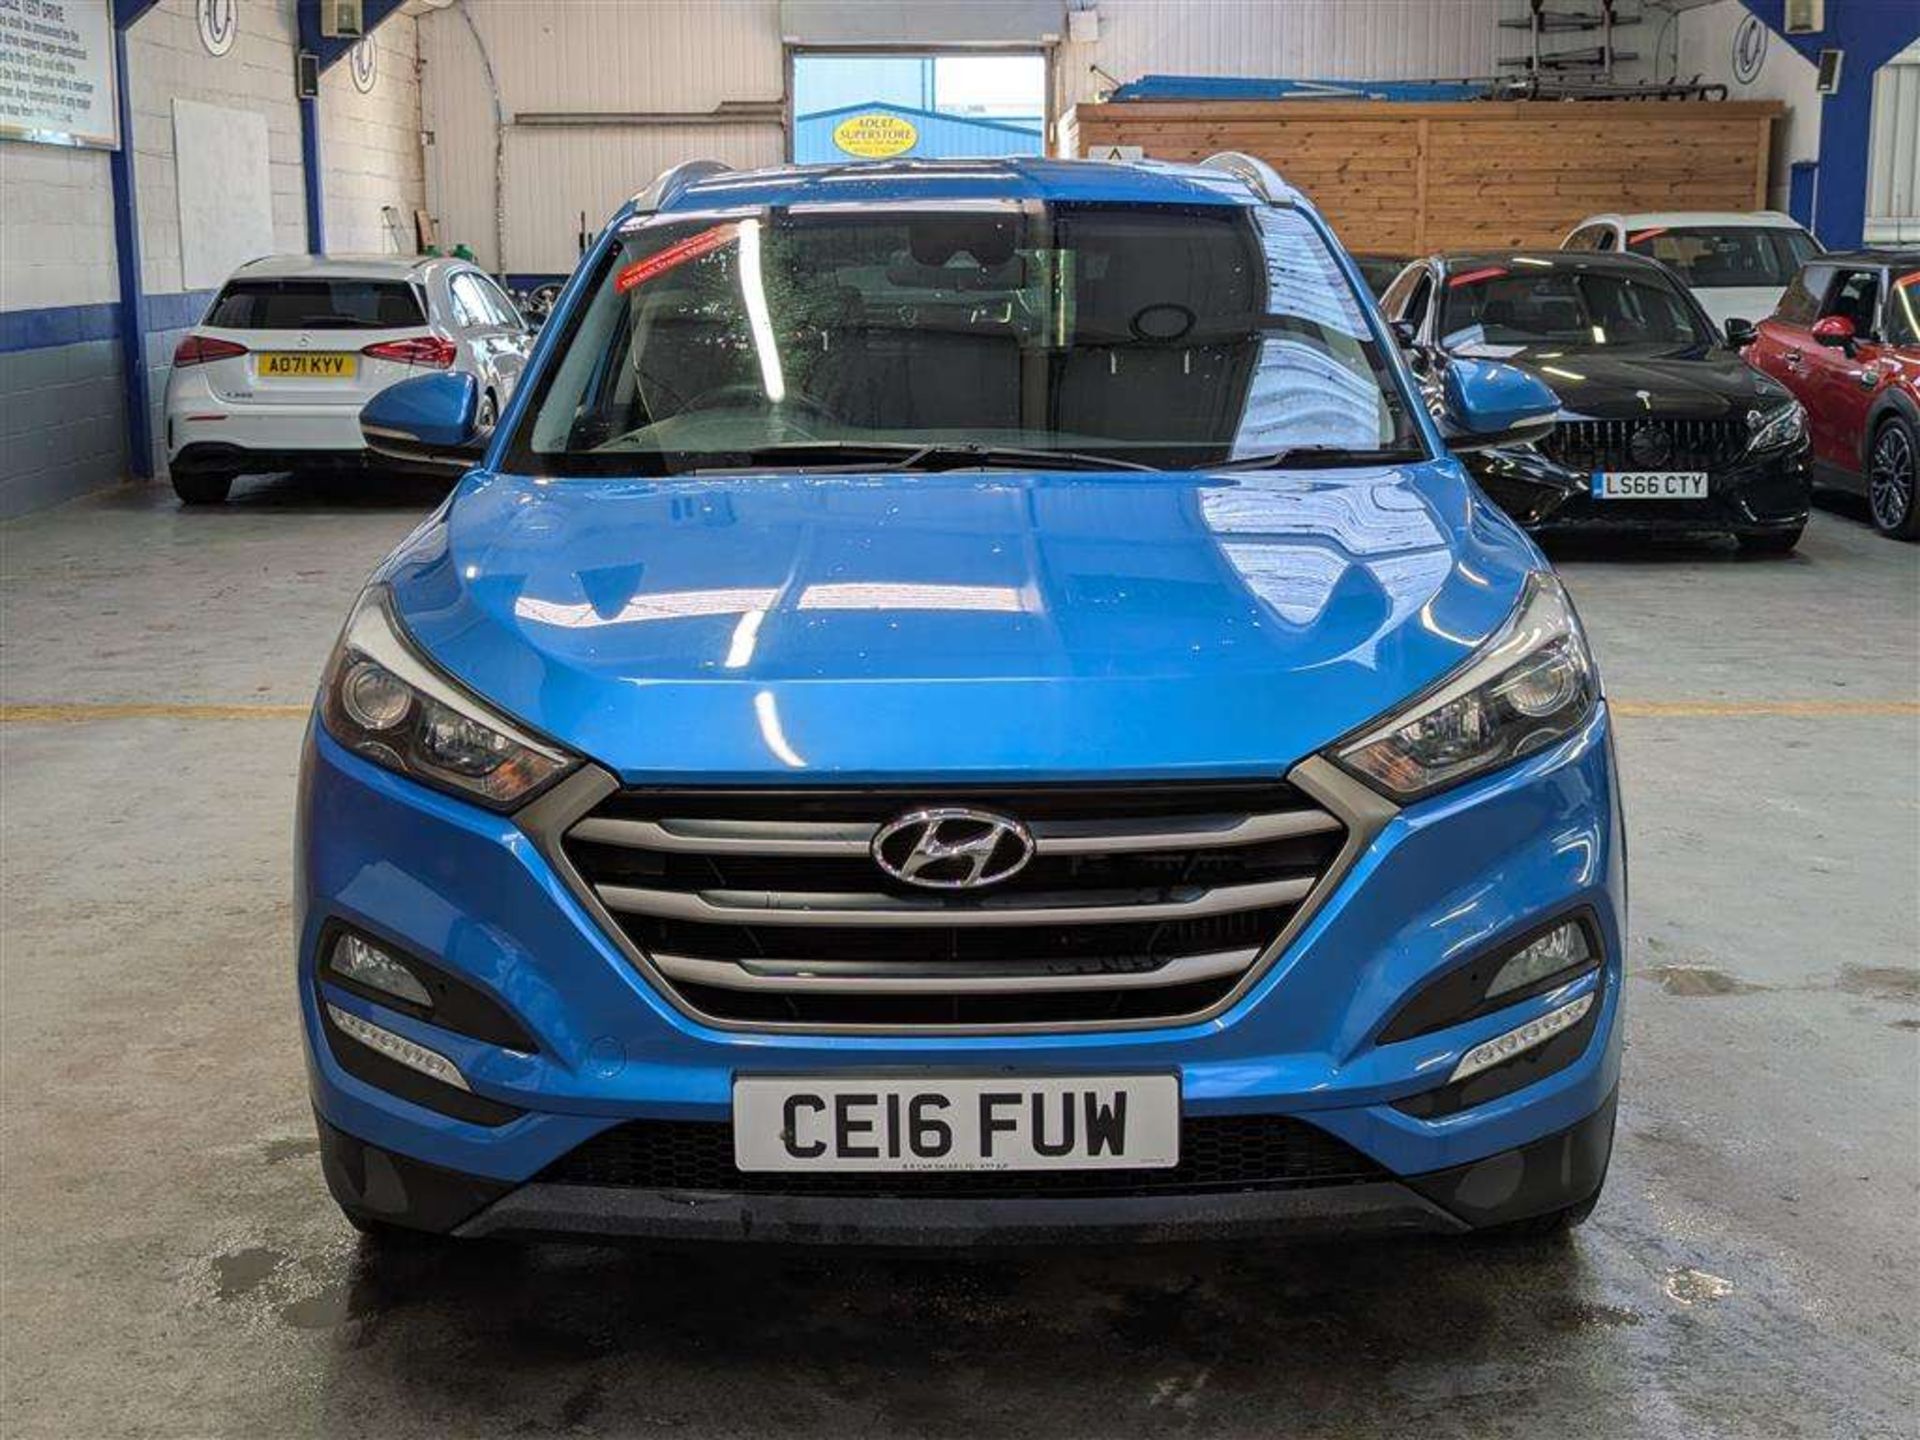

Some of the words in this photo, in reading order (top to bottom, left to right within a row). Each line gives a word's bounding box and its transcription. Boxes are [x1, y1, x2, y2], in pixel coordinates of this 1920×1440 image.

[841, 129, 911, 140] SUPERSTORE
[310, 354, 344, 373] KYV
[1606, 475, 1659, 494] LS66
[1665, 475, 1703, 494] CTY
[782, 1093, 953, 1158] CE16
[979, 1091, 1128, 1158] FUW
